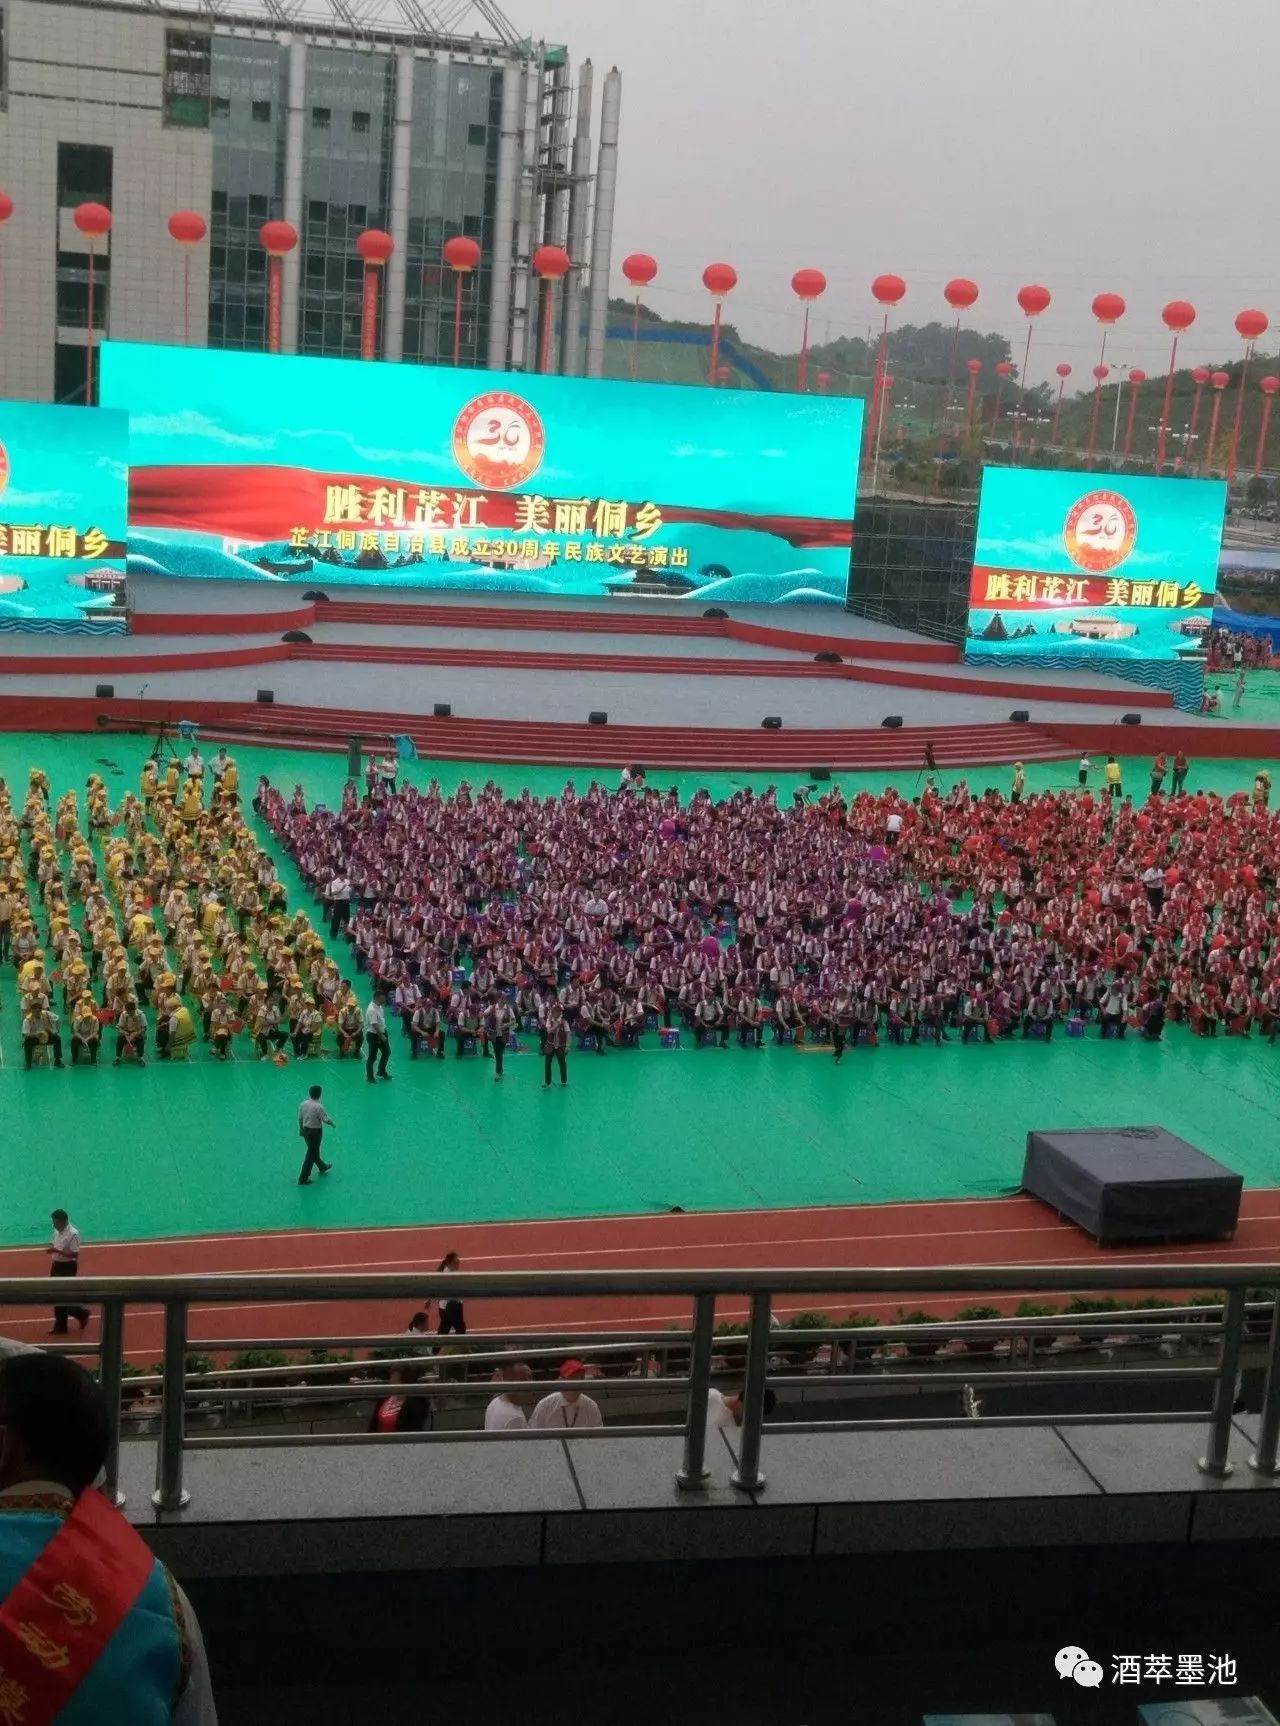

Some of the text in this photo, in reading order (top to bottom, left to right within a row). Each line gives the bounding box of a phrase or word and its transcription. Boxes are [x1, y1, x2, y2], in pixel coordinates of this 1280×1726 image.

[323, 483, 664, 540] 胜利芷江 美丽侗乡
[288, 527, 689, 568] 芷江侗族自治县成立30周年民族文艺演出
[984, 572, 1202, 609] 胜利芷江 美丽侗乡
